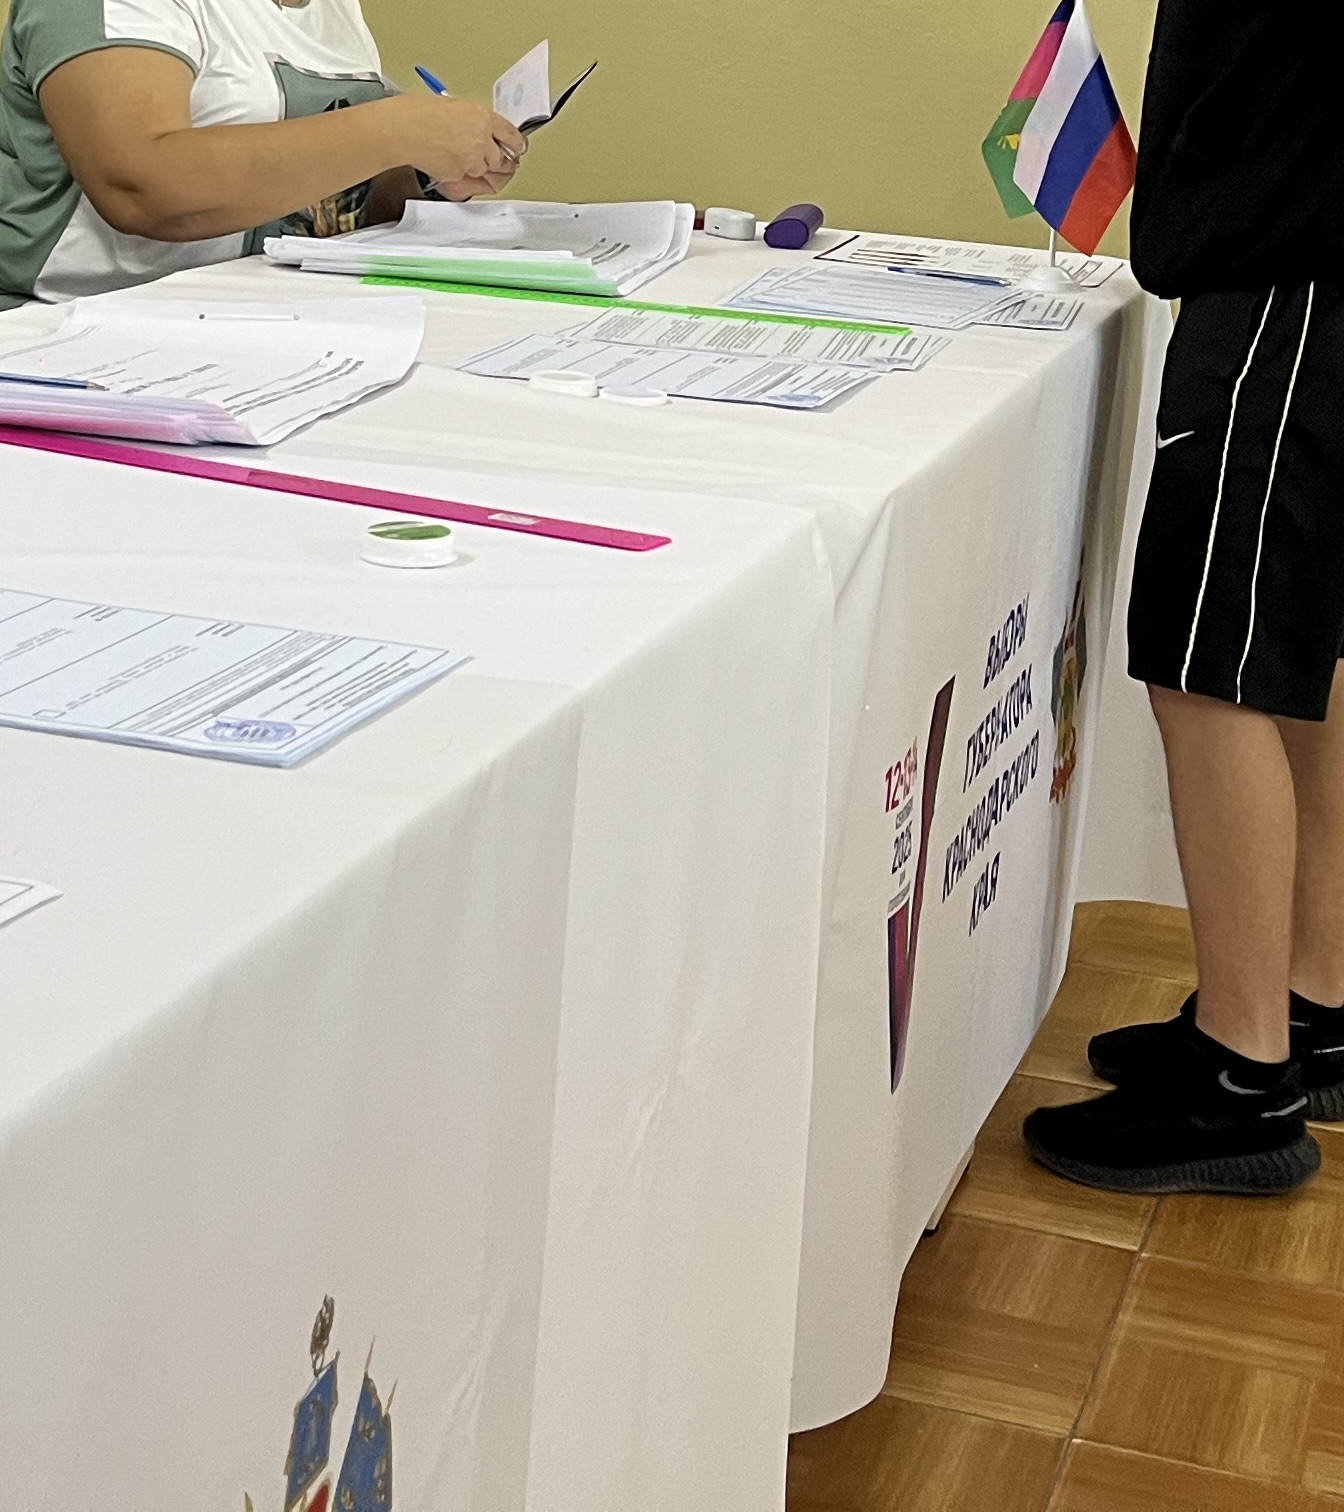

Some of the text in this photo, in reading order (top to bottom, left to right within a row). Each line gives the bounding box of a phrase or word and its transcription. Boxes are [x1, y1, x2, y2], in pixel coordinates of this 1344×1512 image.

[962, 663, 1033, 794] ГУБЕРНАТОРА
[942, 728, 1040, 904] КРАСНОДАРСКОГО
[968, 850, 1001, 938] КРАЯ
